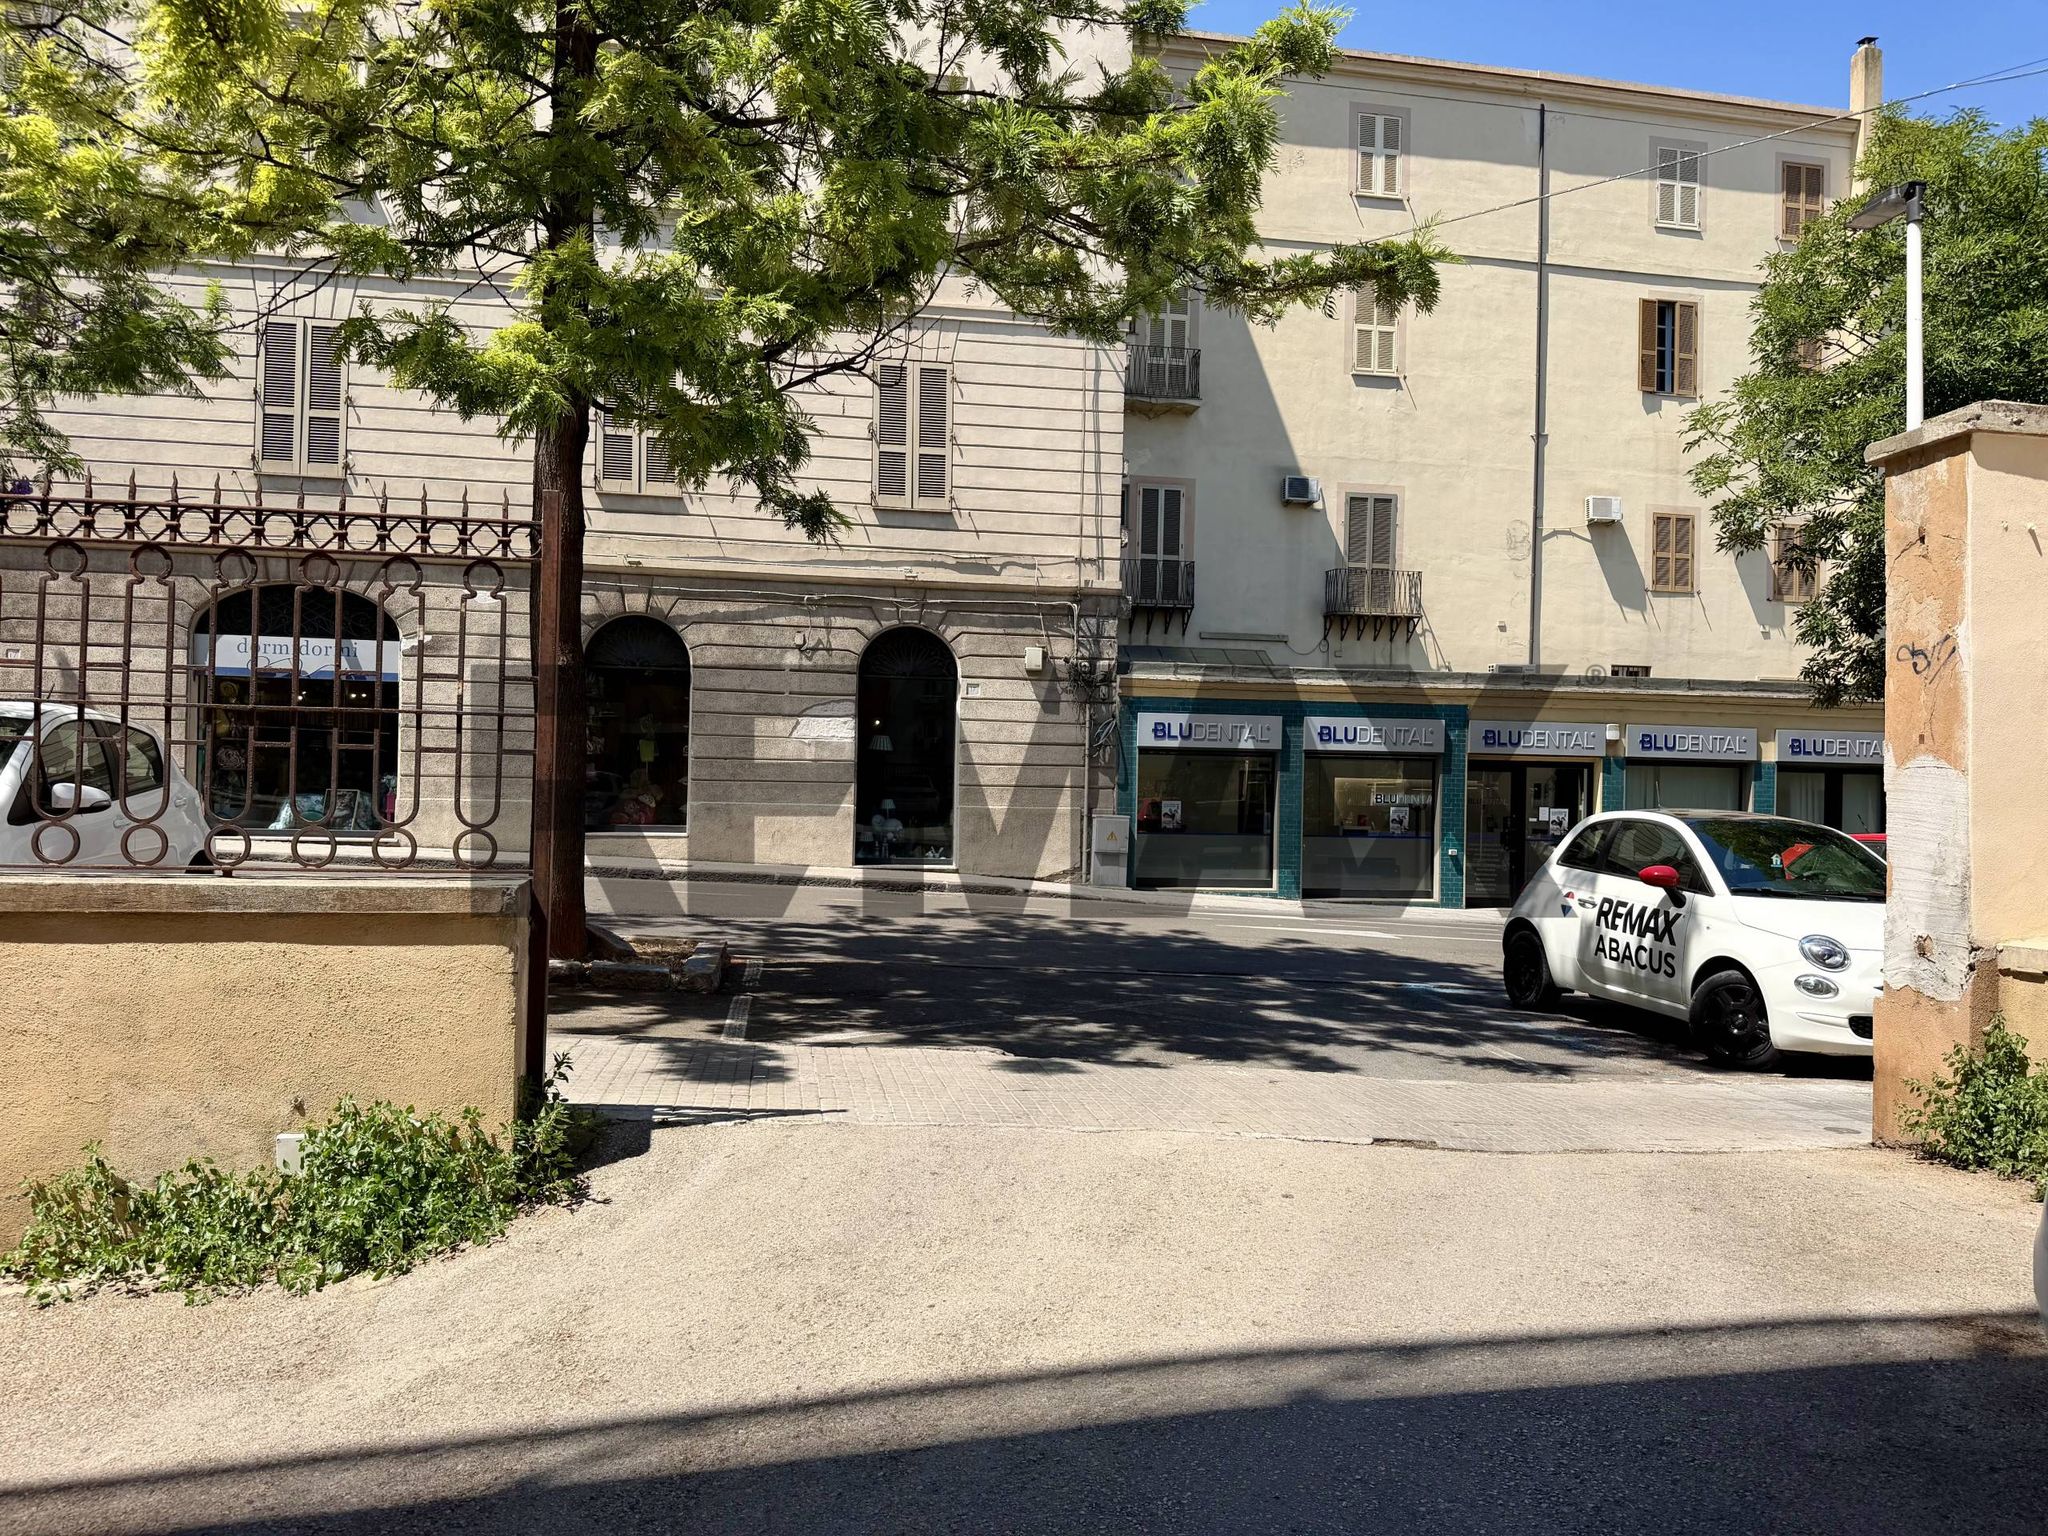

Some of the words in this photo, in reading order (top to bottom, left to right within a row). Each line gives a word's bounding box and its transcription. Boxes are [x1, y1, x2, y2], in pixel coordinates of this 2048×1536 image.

[1152, 721, 1270, 743] BLUDENTAL
[1317, 725, 1433, 747] BLUDENTAL
[1482, 729, 1595, 750] BLUDENTAL
[1639, 733, 1747, 754] BLUDENTAL
[1788, 738, 1884, 758] BLUDENTA
[1594, 934, 1676, 979] ABACUS
